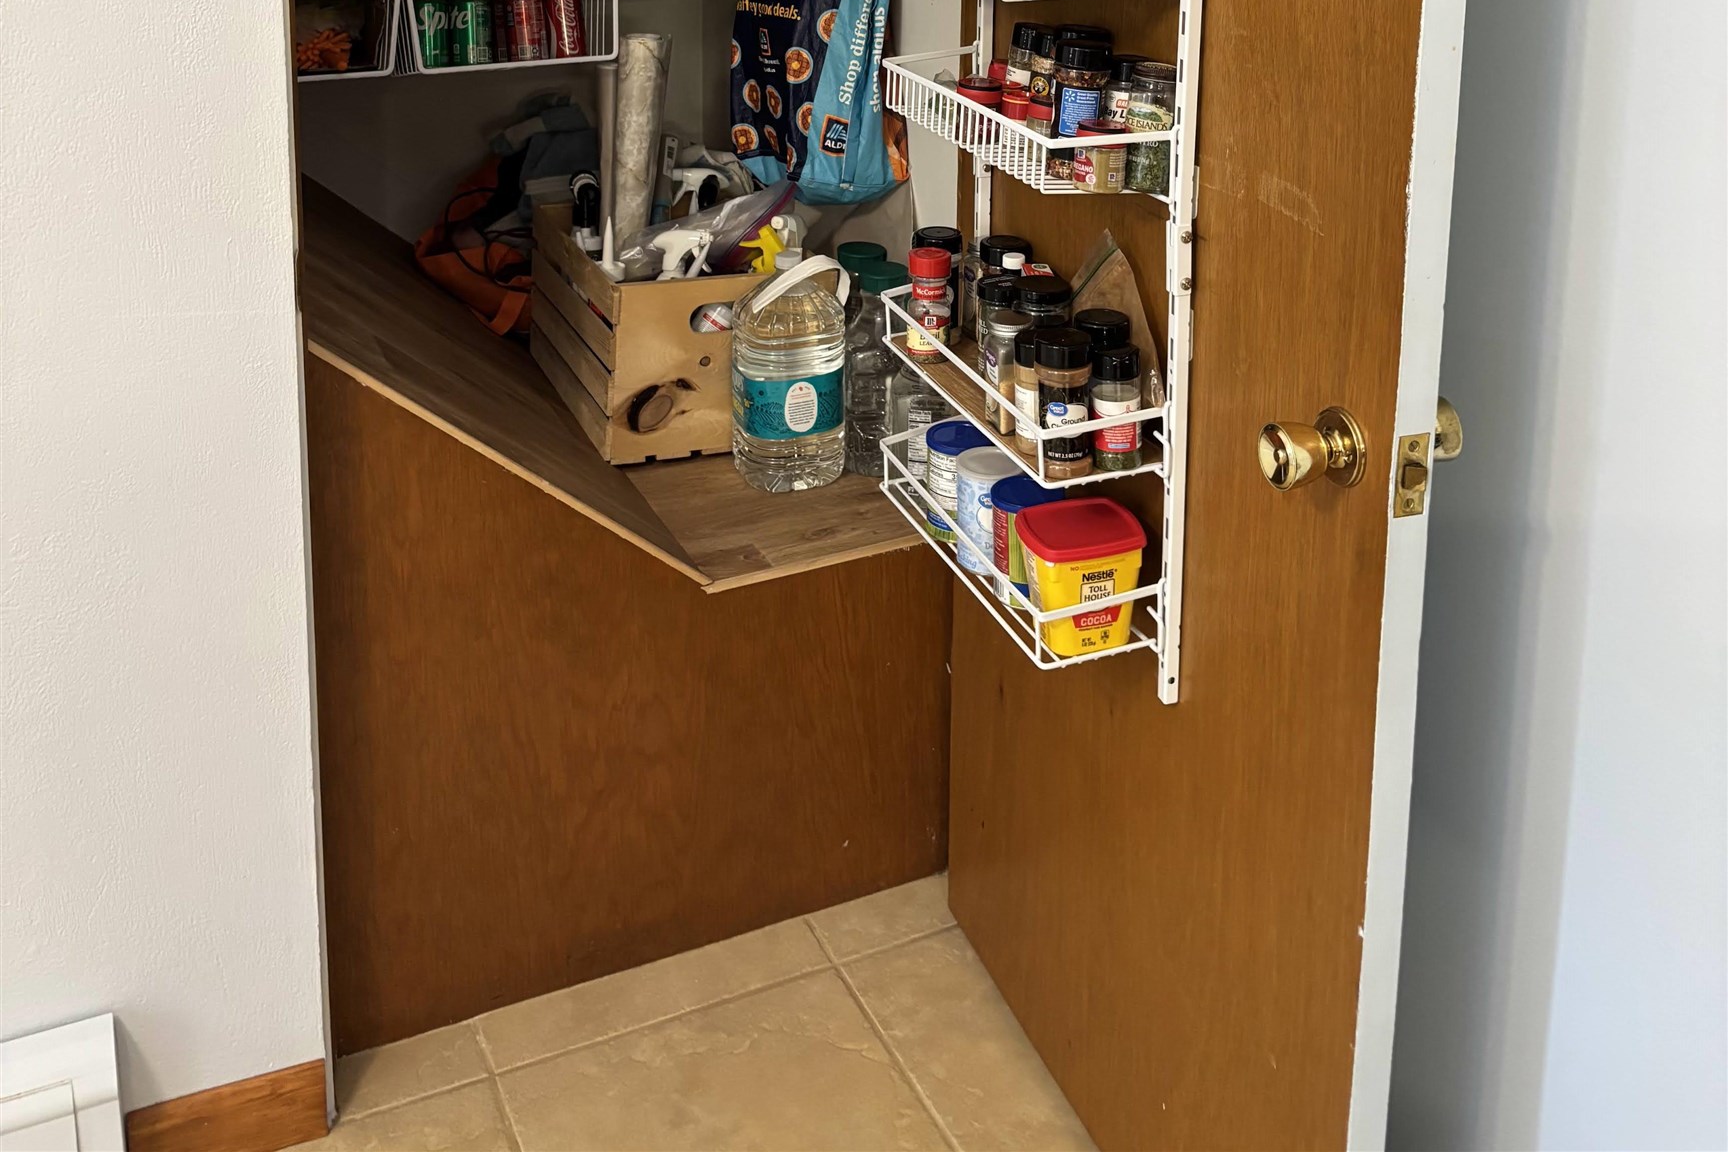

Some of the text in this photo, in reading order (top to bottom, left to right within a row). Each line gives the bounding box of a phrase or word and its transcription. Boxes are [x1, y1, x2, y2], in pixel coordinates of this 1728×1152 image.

[773, 2, 802, 21] deals.
[838, 58, 862, 106] Shop
[1136, 119, 1168, 131] ISLANDS
[1061, 415, 1087, 425] Ground
[1089, 584, 1108, 593] TOLL
[1084, 591, 1112, 602] HOUSE
[1081, 614, 1112, 626] COCOA
